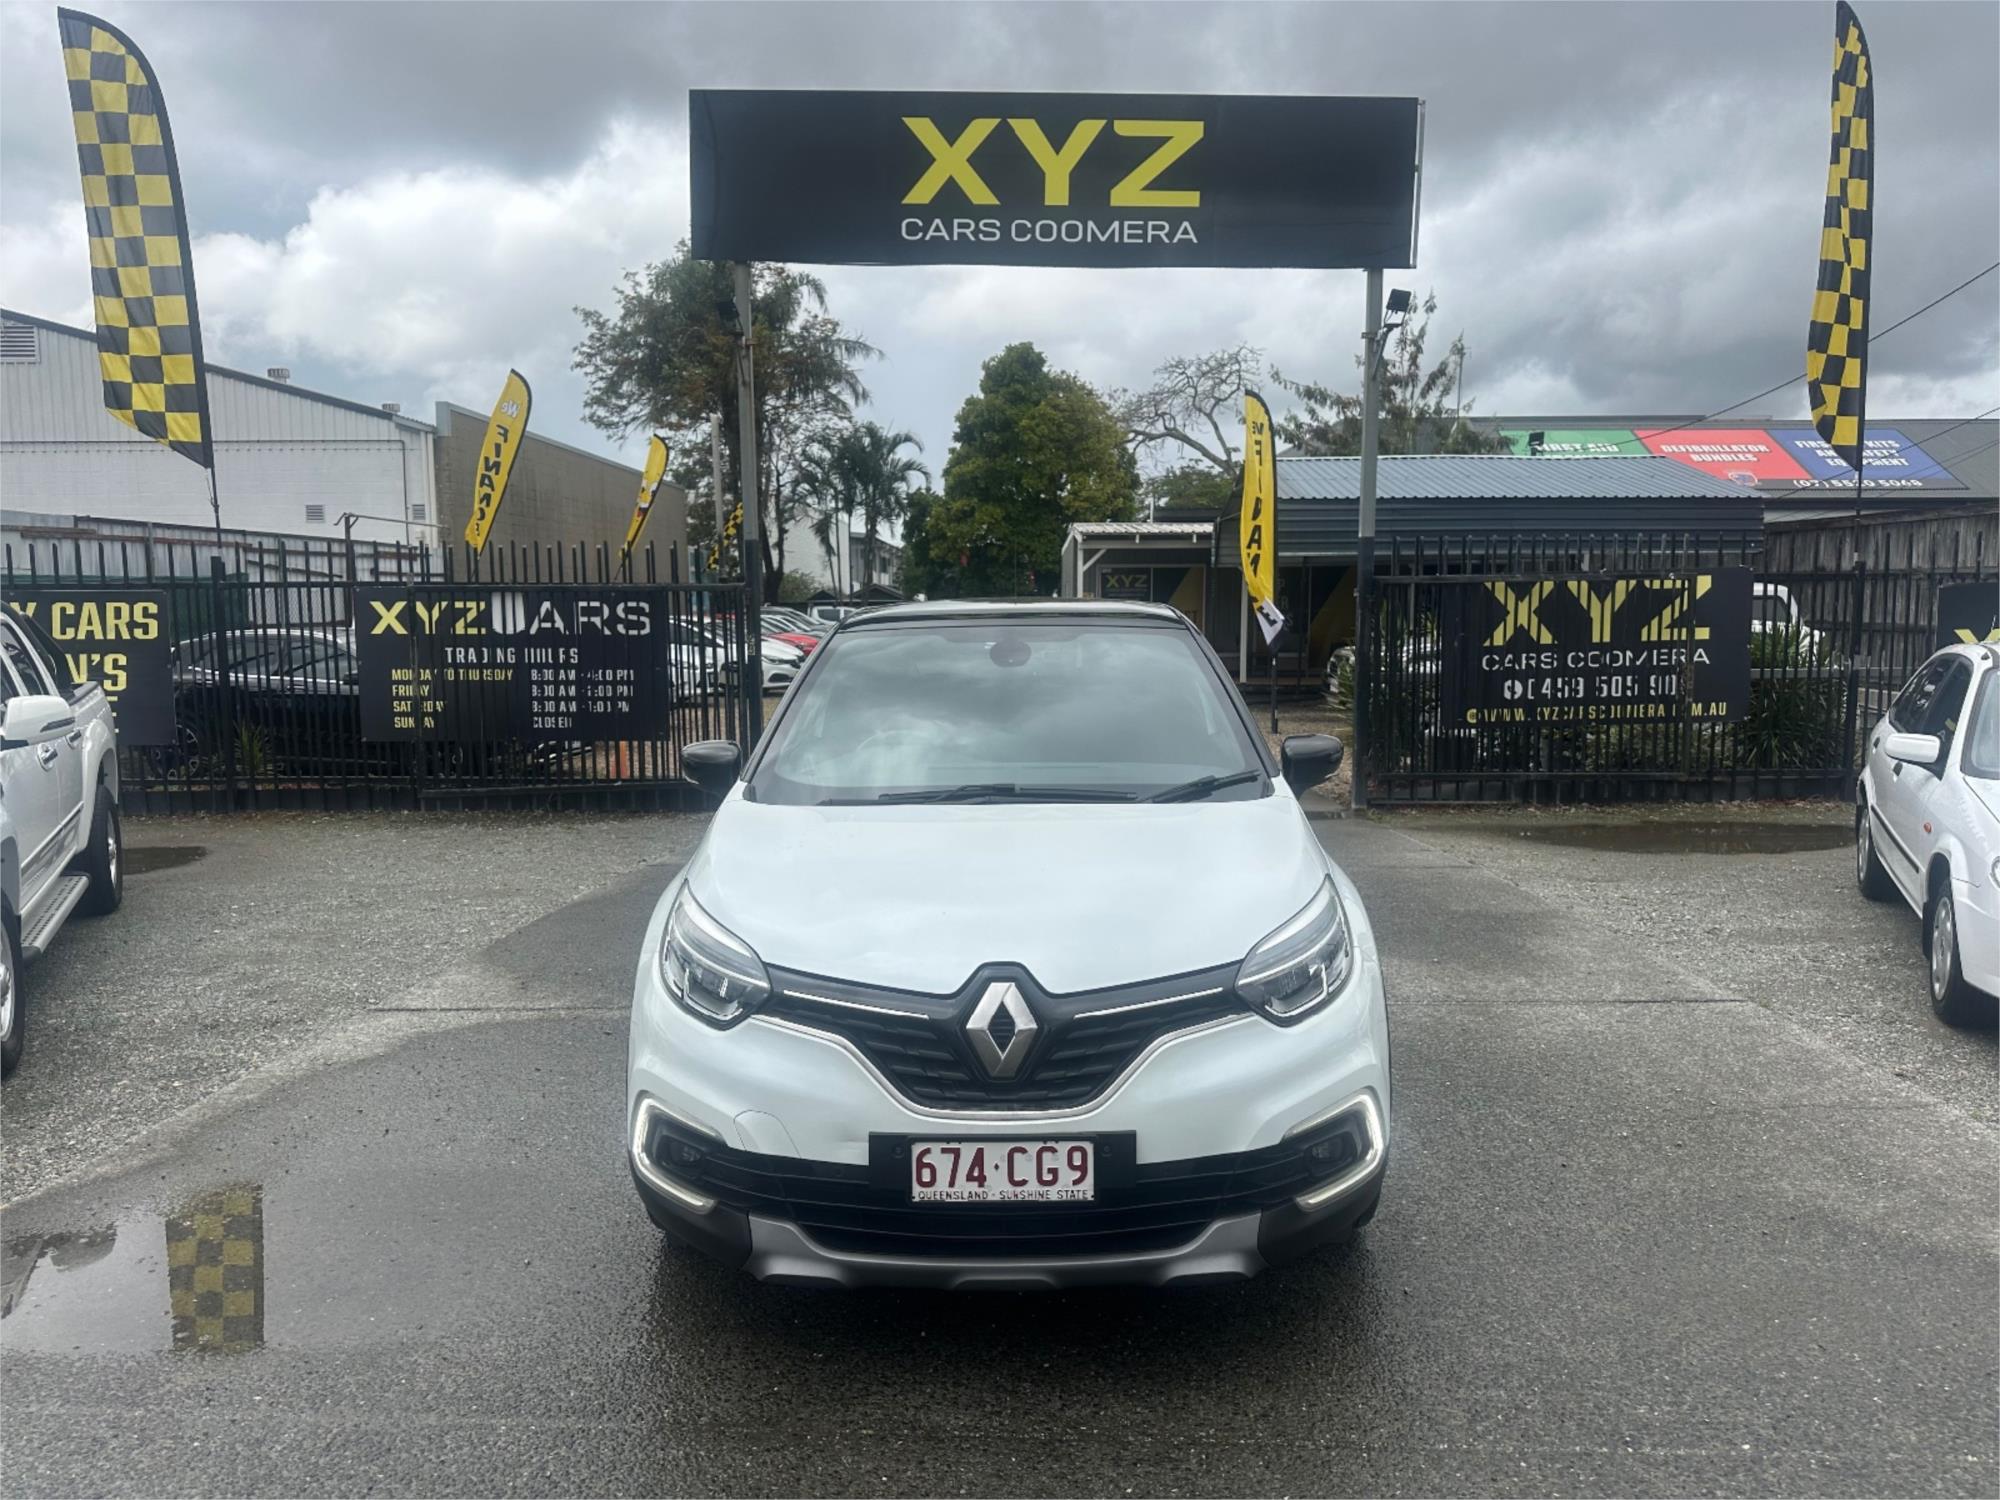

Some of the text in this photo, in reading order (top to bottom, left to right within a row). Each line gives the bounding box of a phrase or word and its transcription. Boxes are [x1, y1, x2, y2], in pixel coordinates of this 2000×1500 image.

[901, 117, 1205, 208] XYZ
[900, 218, 1199, 244] CARS COOMERA
[1659, 443, 1771, 454] DEFIBRILLATOR
[1794, 440, 1831, 449] FIRS
[1690, 452, 1759, 463] BUNDLES
[1861, 449, 1900, 458] AFETY
[1825, 457, 1910, 467] EQPMENT
[1106, 574, 1149, 588] XYZ
[1482, 574, 1713, 647] XYZ
[51, 601, 160, 641] CARS
[369, 600, 488, 636] XYZ
[1481, 651, 1558, 672] CARS
[918, 1189, 1090, 1201] QUEENSLAND SUNSHINE STATE
